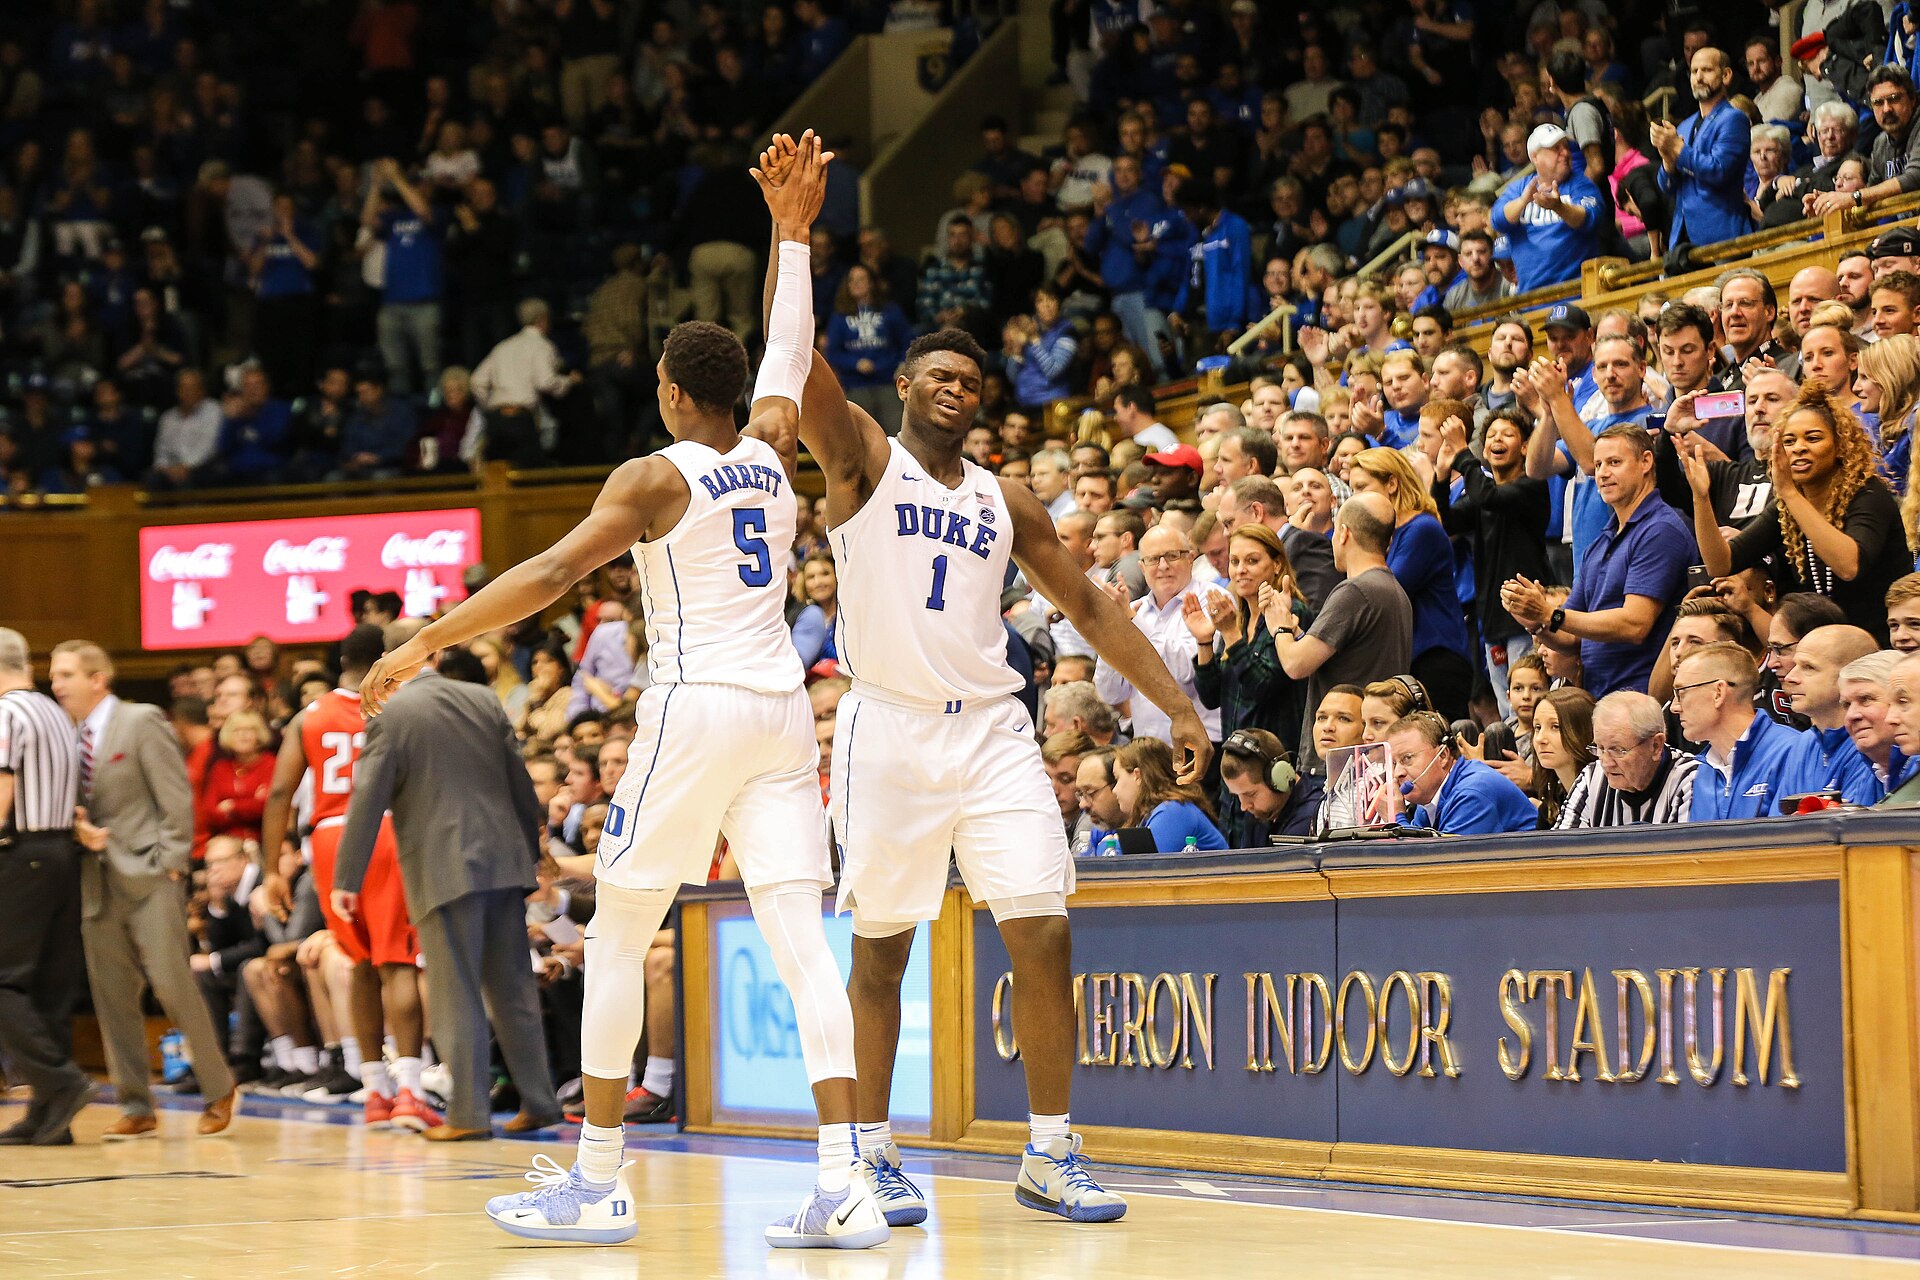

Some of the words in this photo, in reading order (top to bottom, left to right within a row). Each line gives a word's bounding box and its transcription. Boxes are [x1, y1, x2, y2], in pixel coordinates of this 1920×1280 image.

[699, 465, 781, 500] BARRETT
[731, 508, 772, 587] 5
[895, 503, 997, 560] DUKE
[925, 554, 947, 611] 1
[991, 971, 1219, 1071] CERON
[1241, 970, 1461, 1078] INDOOR
[1497, 966, 1802, 1089] STADIUM
[610, 1200, 627, 1217] D
